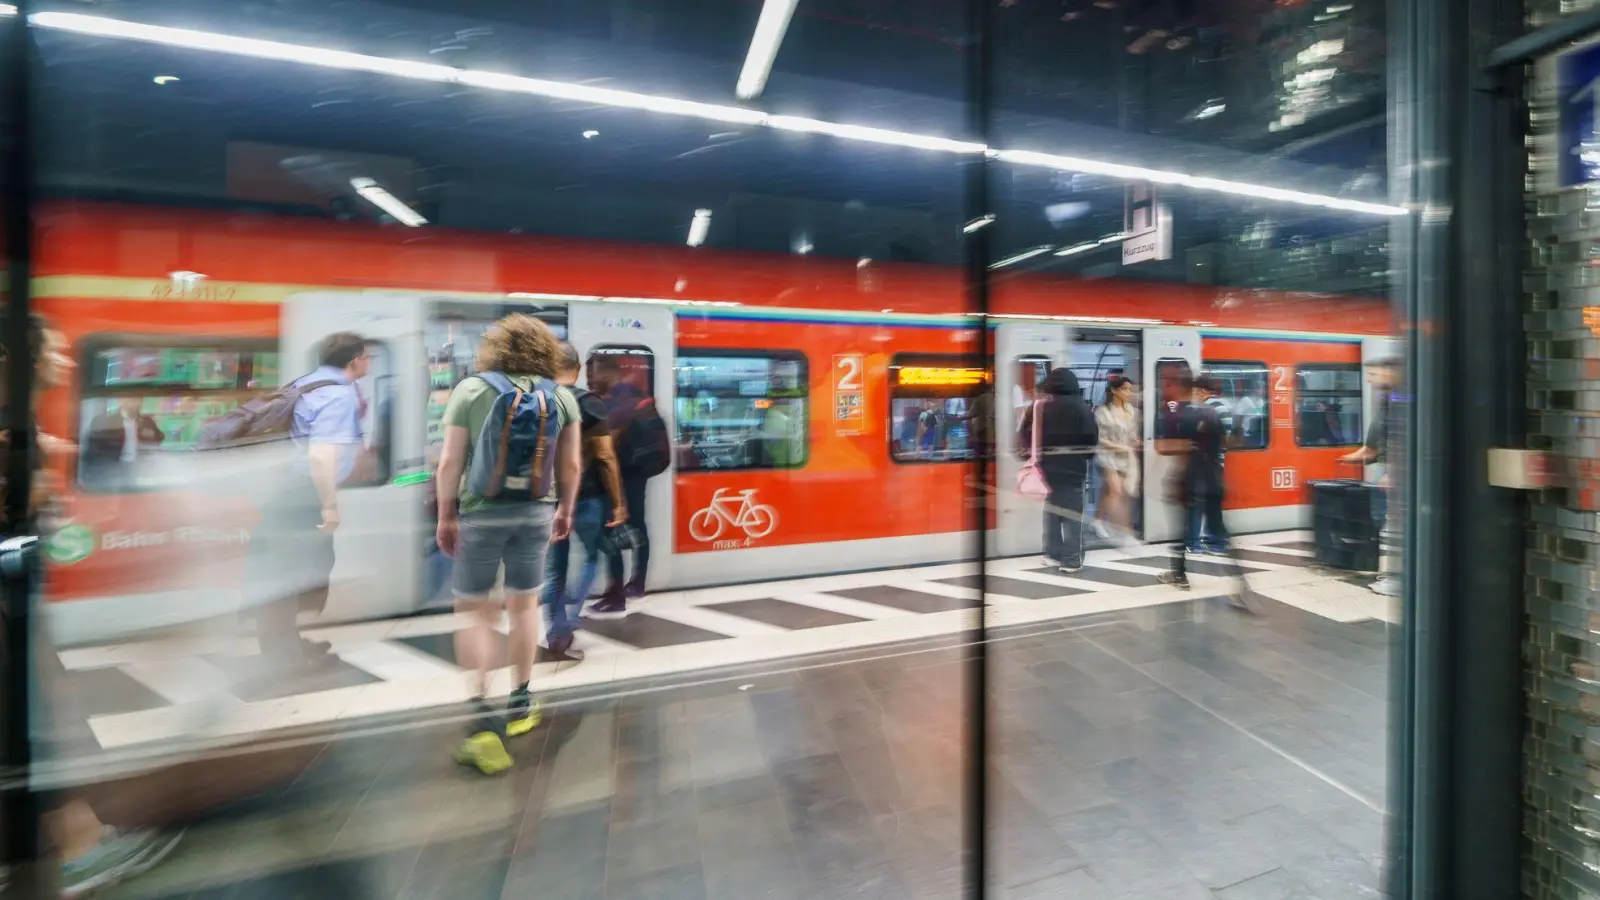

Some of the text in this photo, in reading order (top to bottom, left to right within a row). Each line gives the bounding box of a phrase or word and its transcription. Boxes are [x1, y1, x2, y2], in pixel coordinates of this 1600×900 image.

[1123, 243, 1155, 257] Kurzzug
[837, 357, 858, 390] 2
[1273, 366, 1290, 390] 2
[1273, 470, 1292, 487] DB
